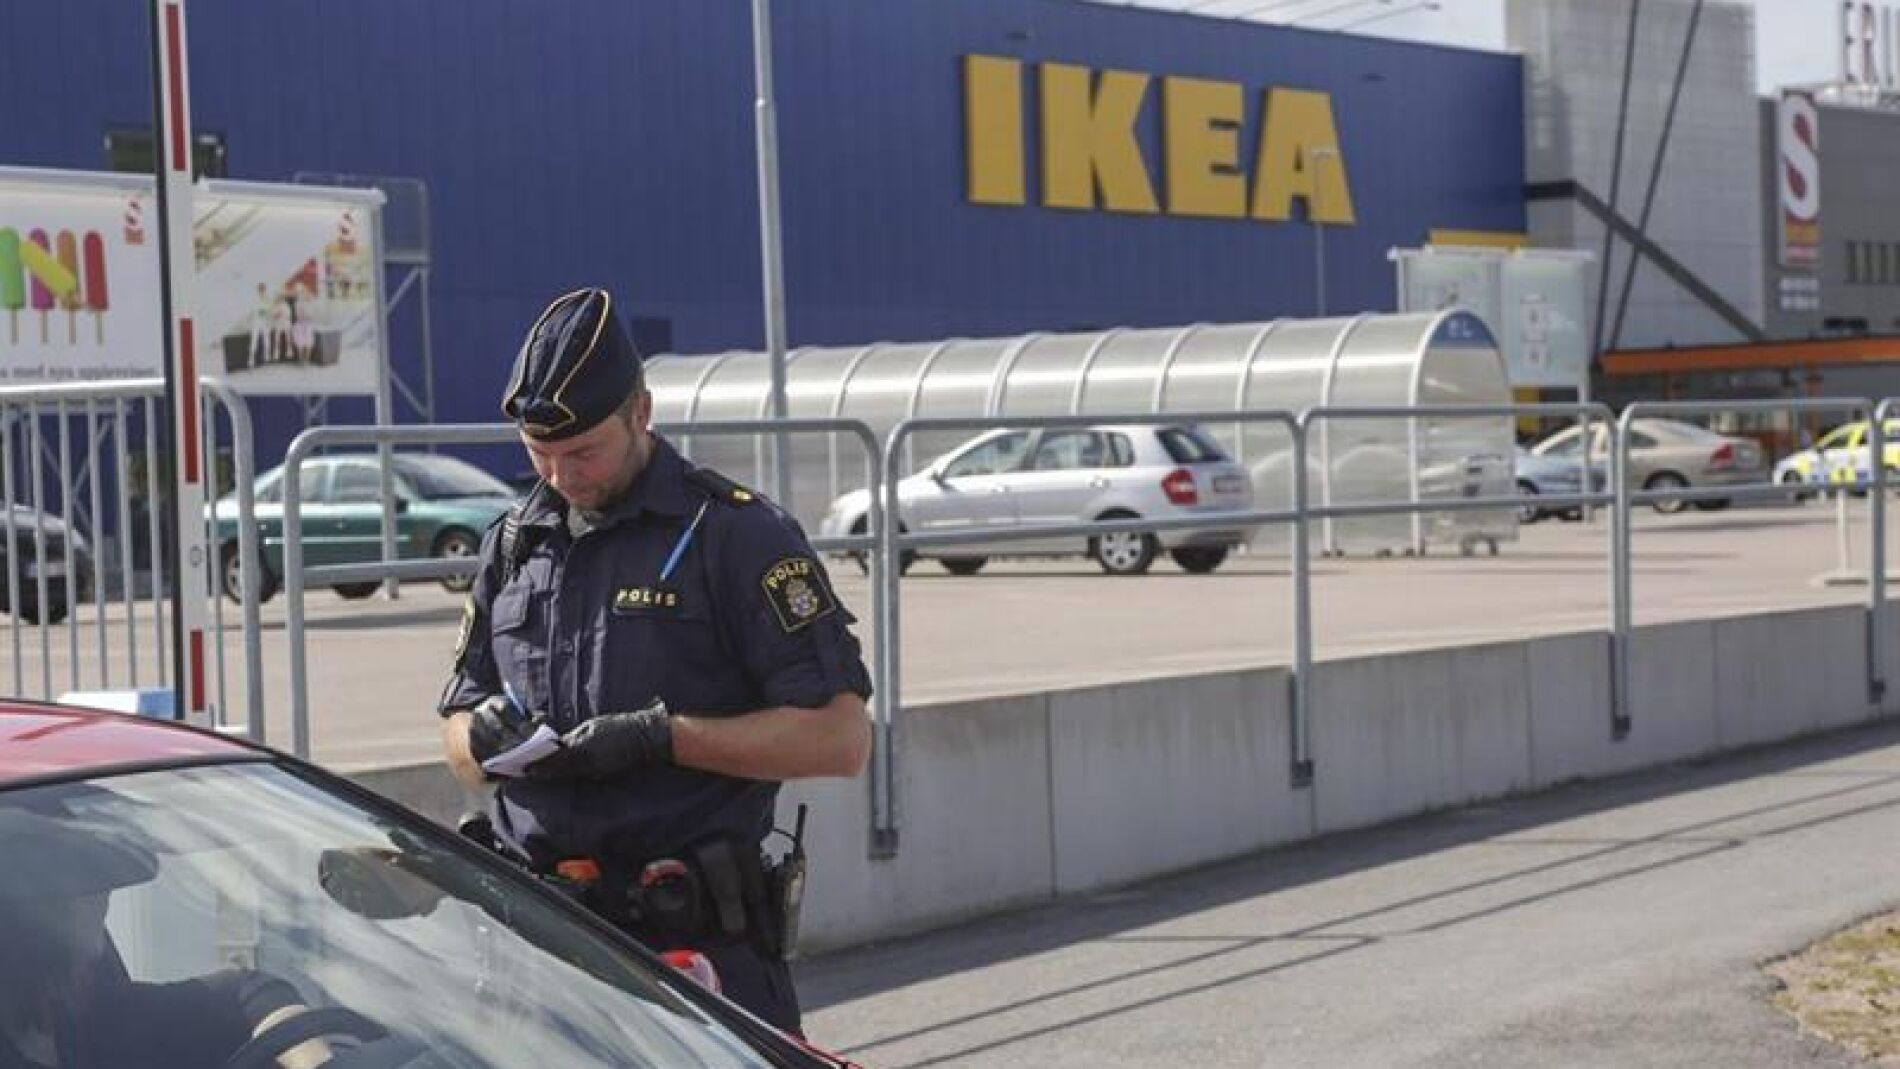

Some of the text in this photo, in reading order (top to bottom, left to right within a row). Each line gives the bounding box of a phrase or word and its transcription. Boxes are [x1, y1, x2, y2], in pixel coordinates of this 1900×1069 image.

[964, 53, 1356, 226] IKEA
[766, 562, 809, 589] POLIS
[616, 587, 677, 607] POLIS
